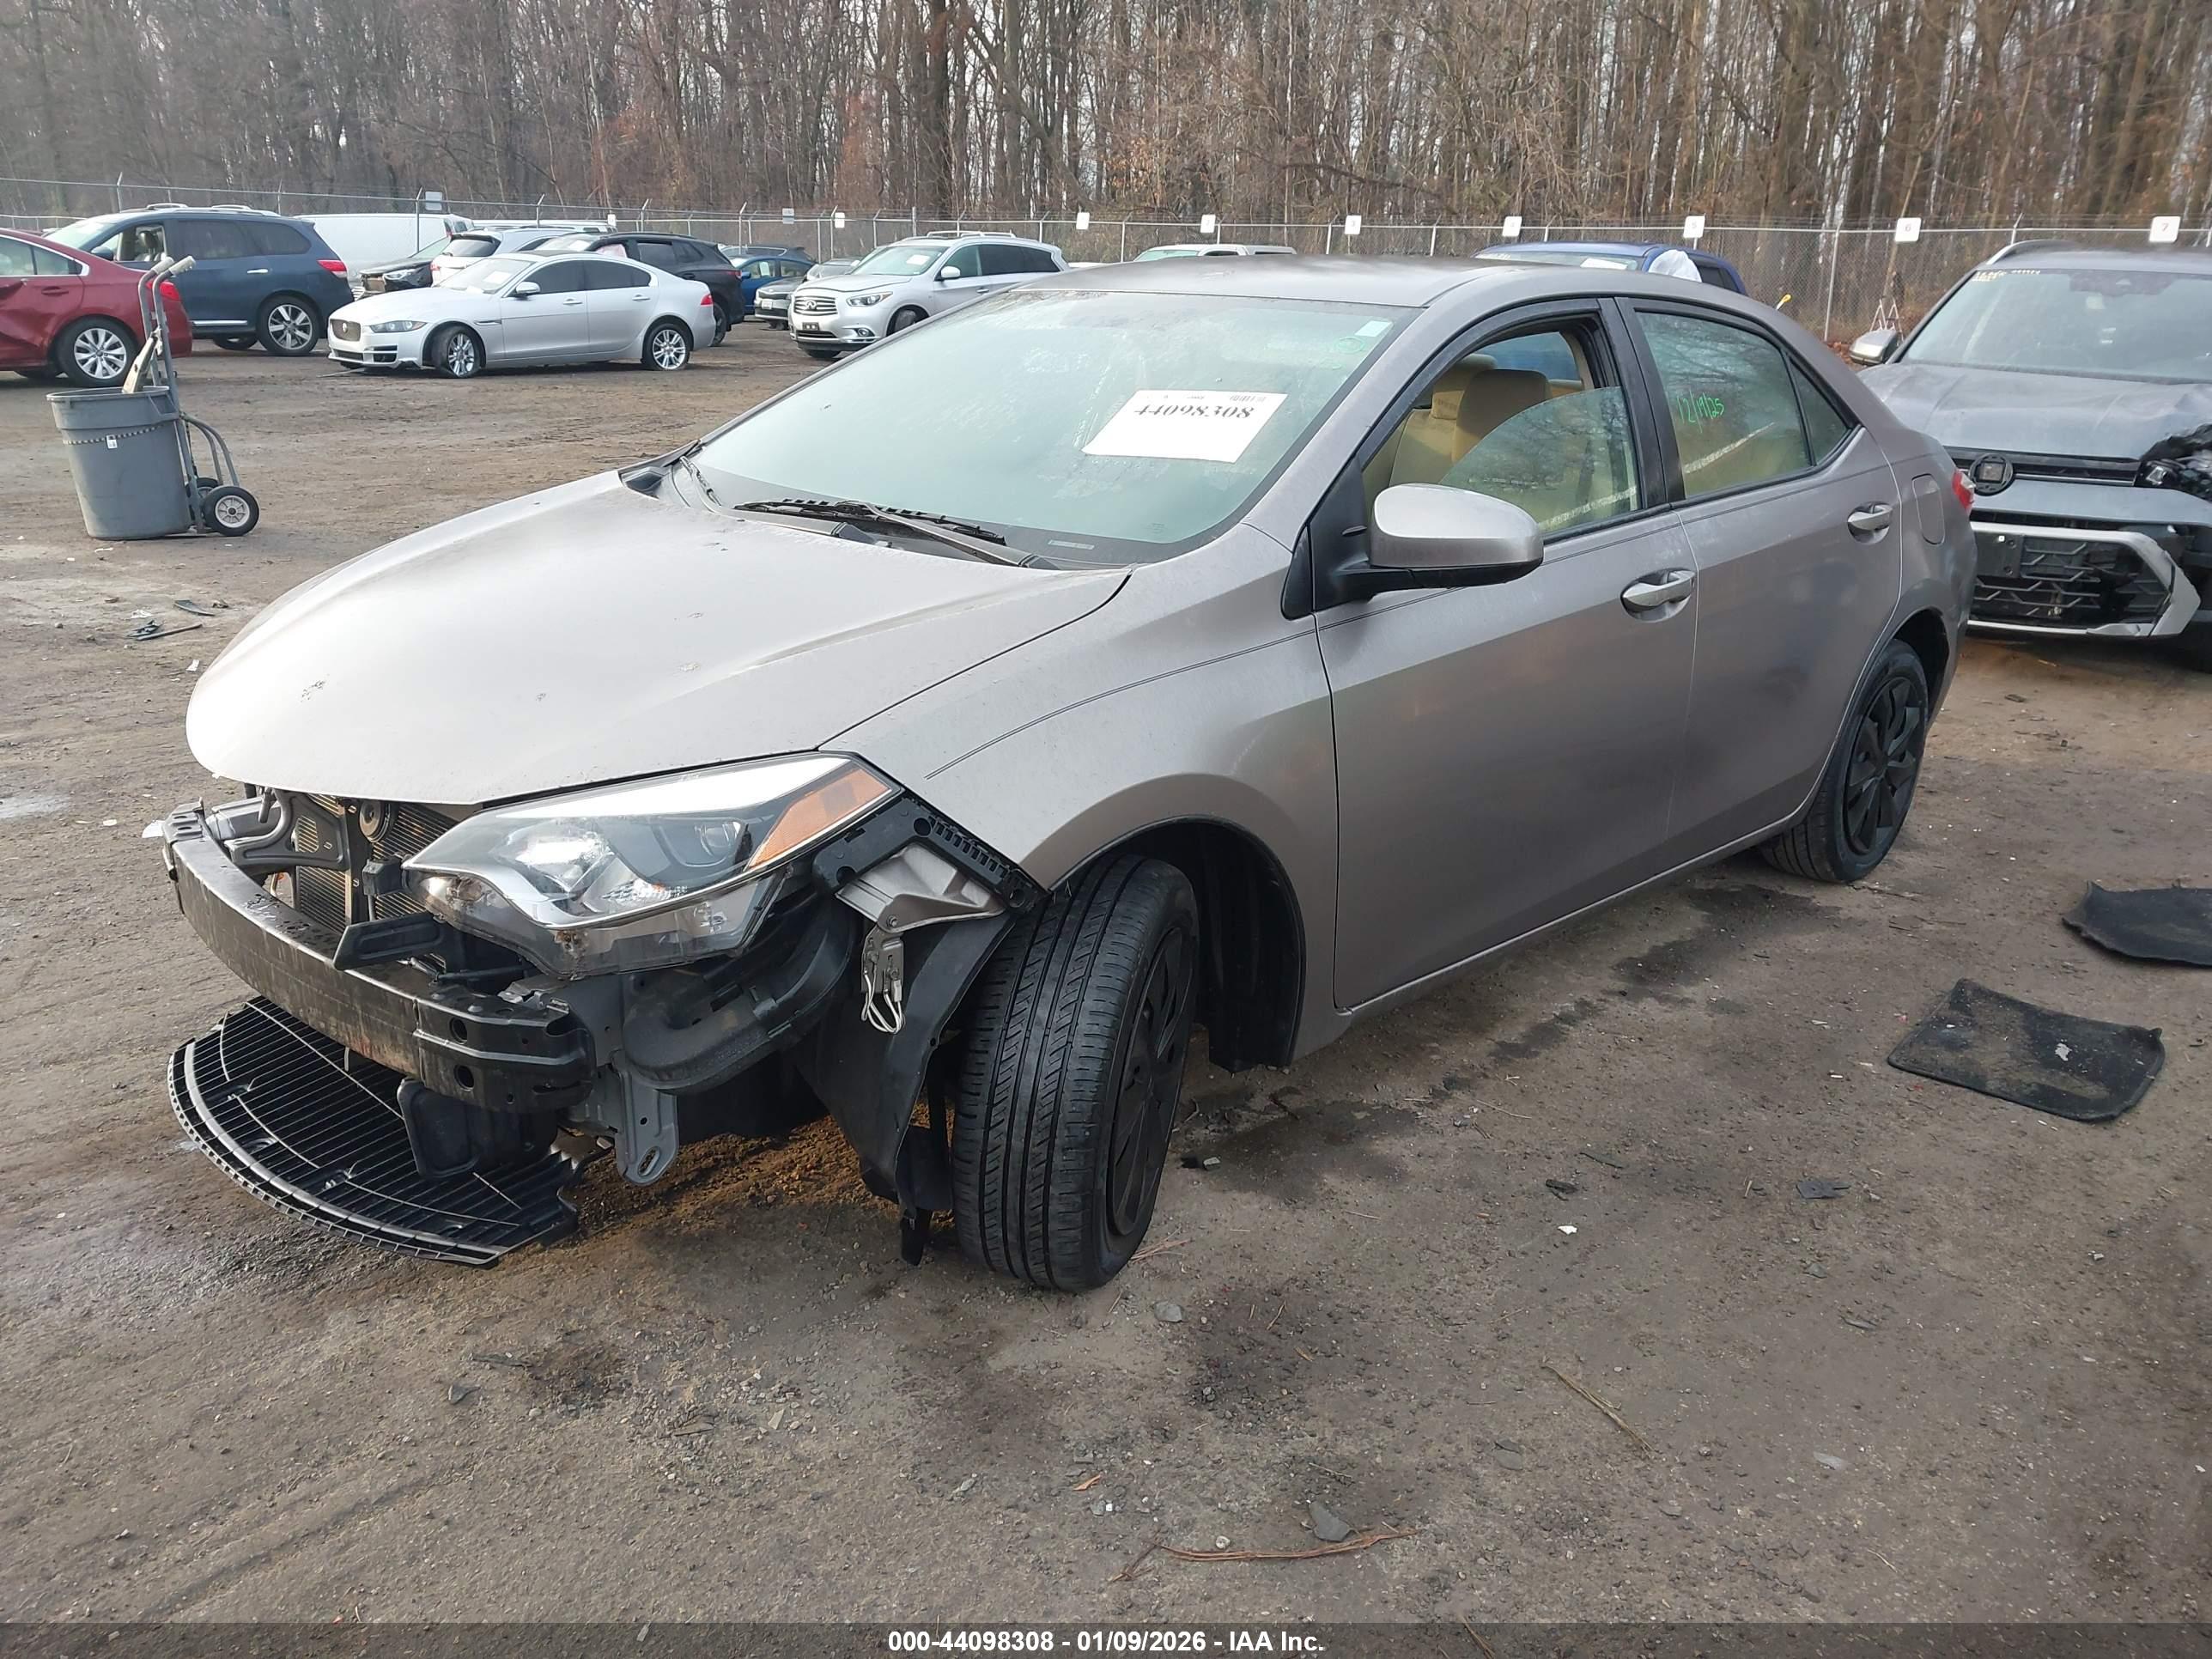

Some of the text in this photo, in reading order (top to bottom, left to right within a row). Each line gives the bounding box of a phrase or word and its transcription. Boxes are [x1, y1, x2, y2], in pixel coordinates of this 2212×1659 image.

[1905, 222, 1911, 232] 6
[2161, 222, 2170, 232] 7
[1133, 404, 1255, 418] 44098308
[1676, 389, 1724, 433] 12/19/25
